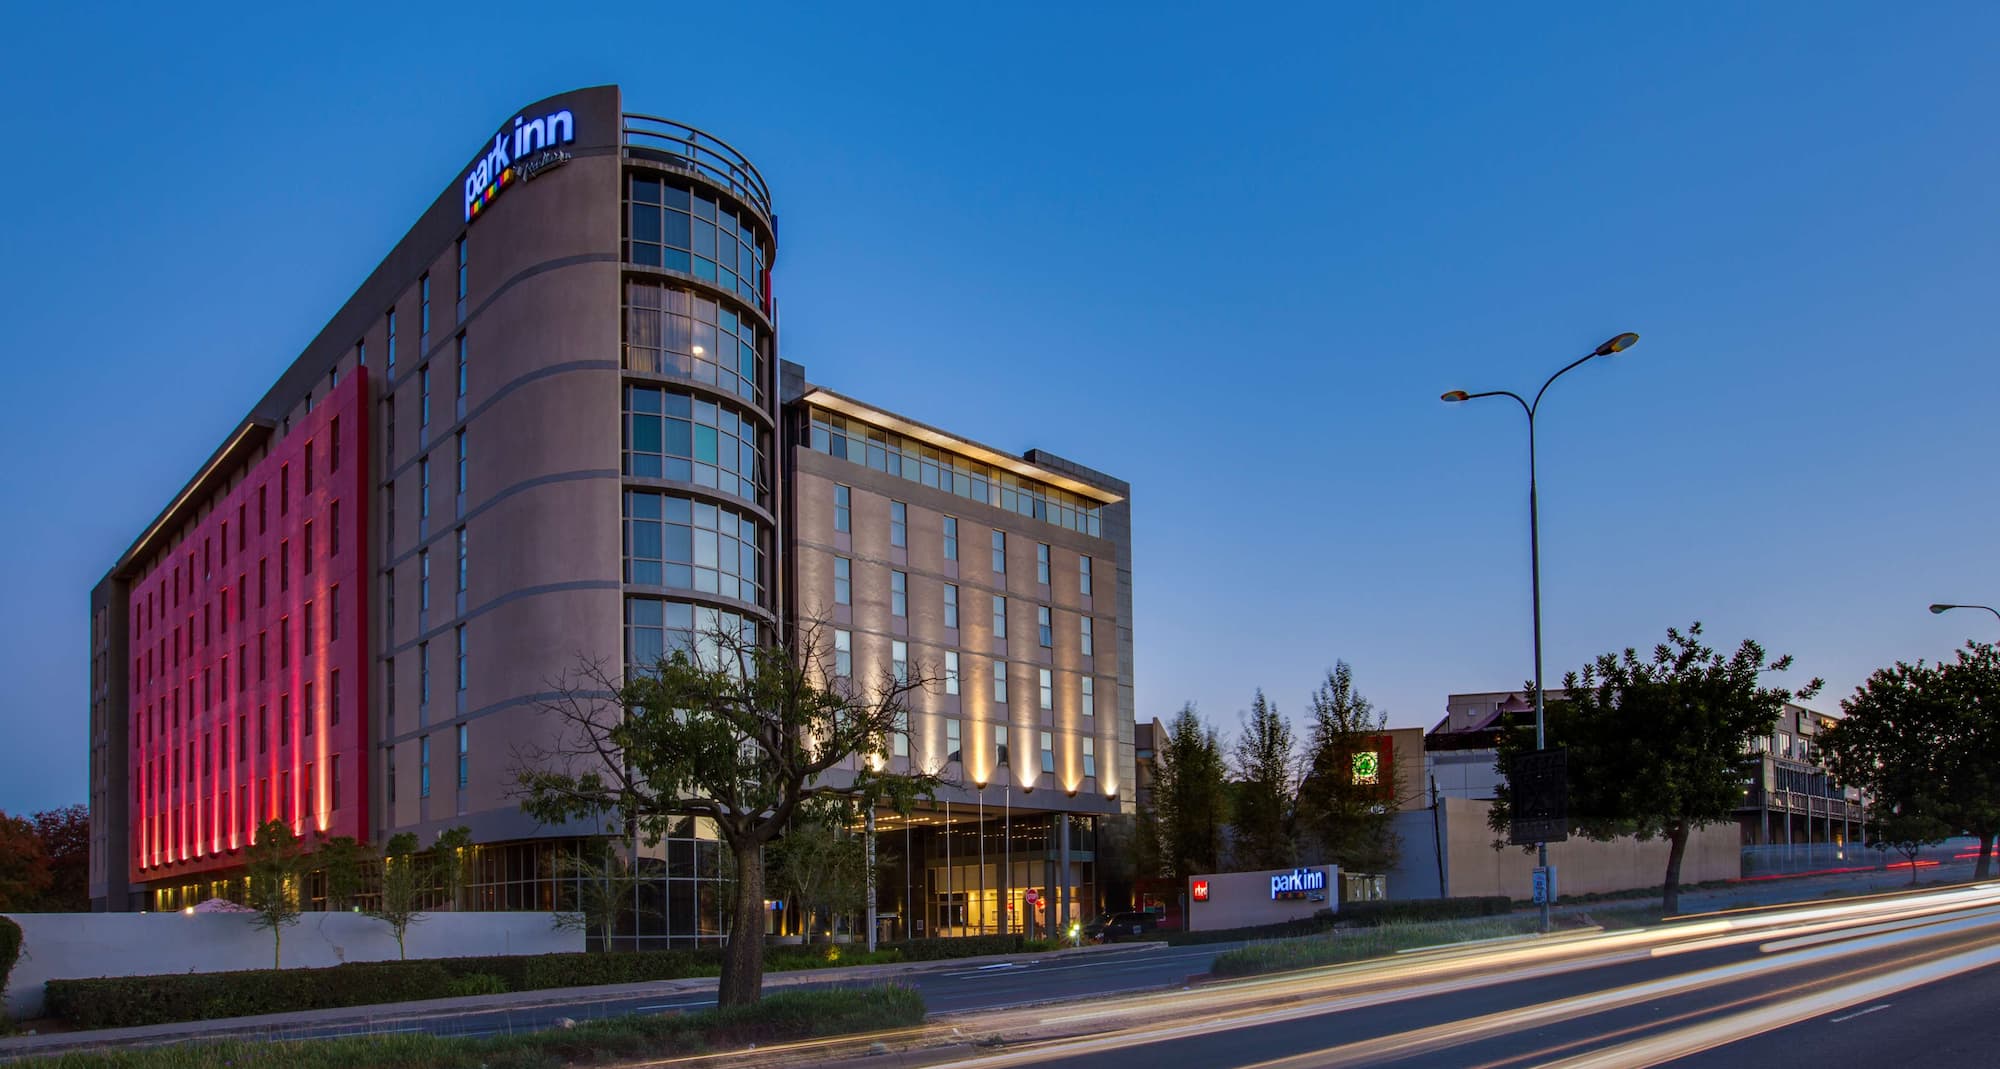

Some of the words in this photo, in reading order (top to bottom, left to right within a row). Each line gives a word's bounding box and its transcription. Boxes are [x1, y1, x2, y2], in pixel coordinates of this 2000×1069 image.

[464, 131, 511, 223] park
[514, 109, 574, 160] inn
[1271, 868, 1303, 899] park
[1303, 868, 1323, 890] inn
